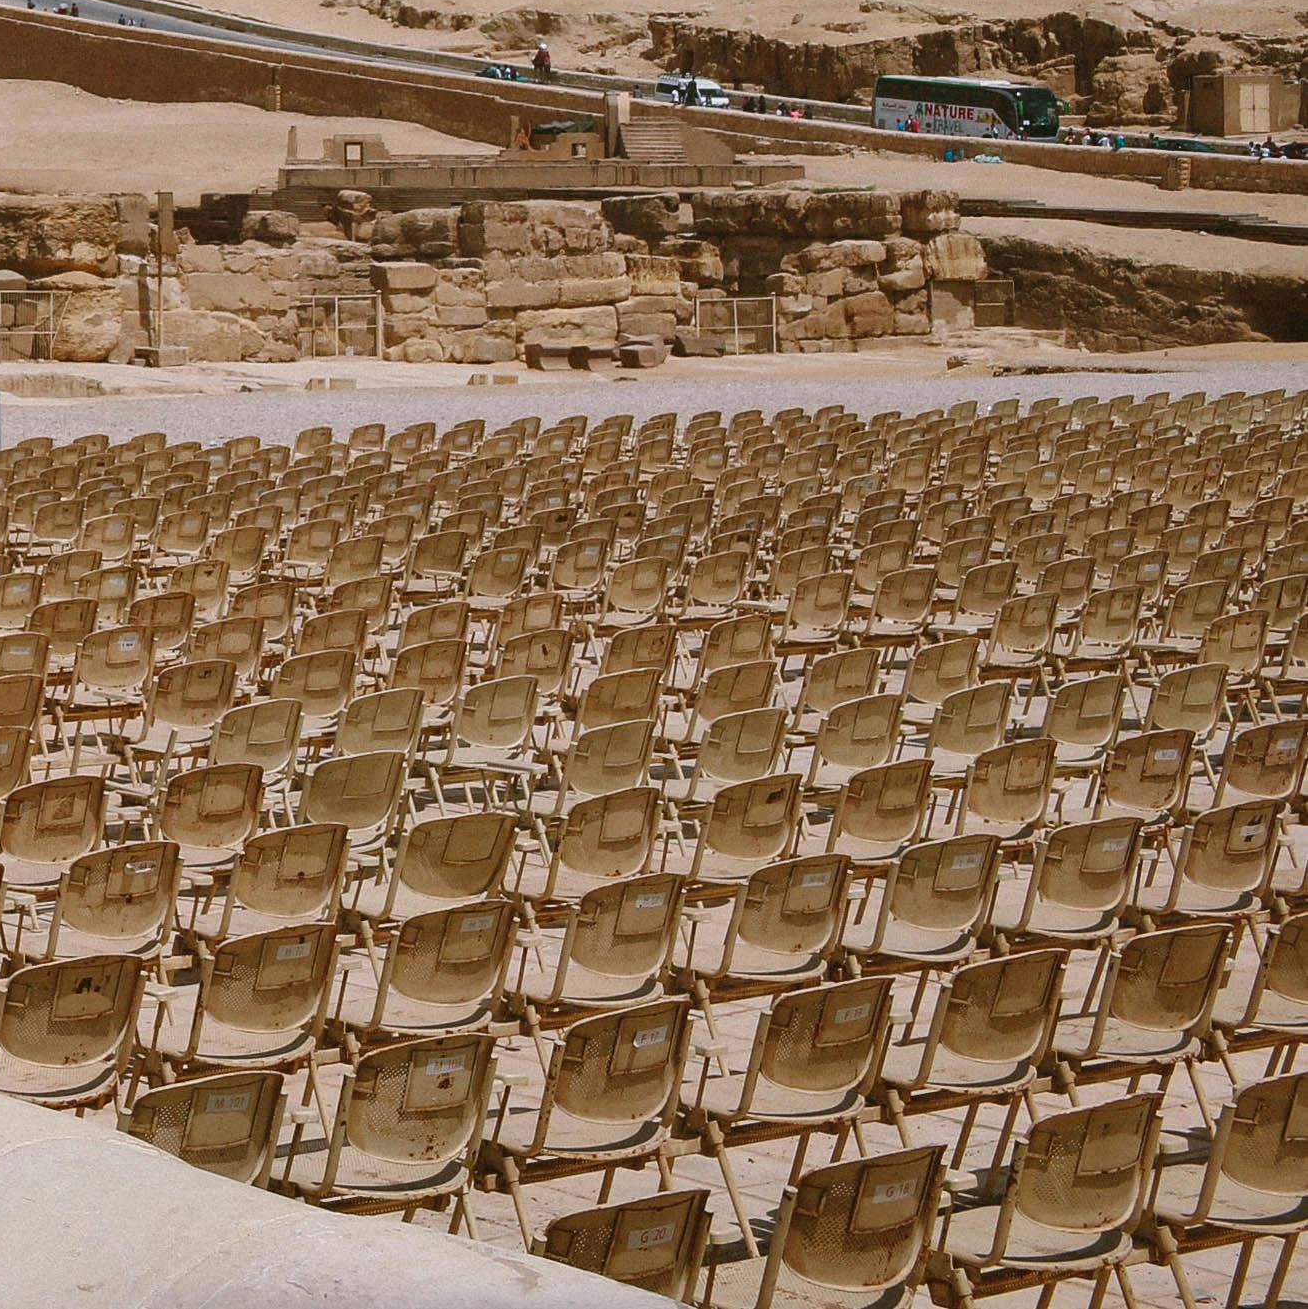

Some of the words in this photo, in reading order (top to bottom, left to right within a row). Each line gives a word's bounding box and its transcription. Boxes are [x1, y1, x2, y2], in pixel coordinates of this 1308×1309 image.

[924, 103, 975, 121] NATURE
[934, 116, 963, 133] TRAVEL
[640, 1033, 648, 1043] F
[885, 1185, 895, 1198] G
[640, 1230, 650, 1244] G
[652, 1227, 667, 1242] 20
